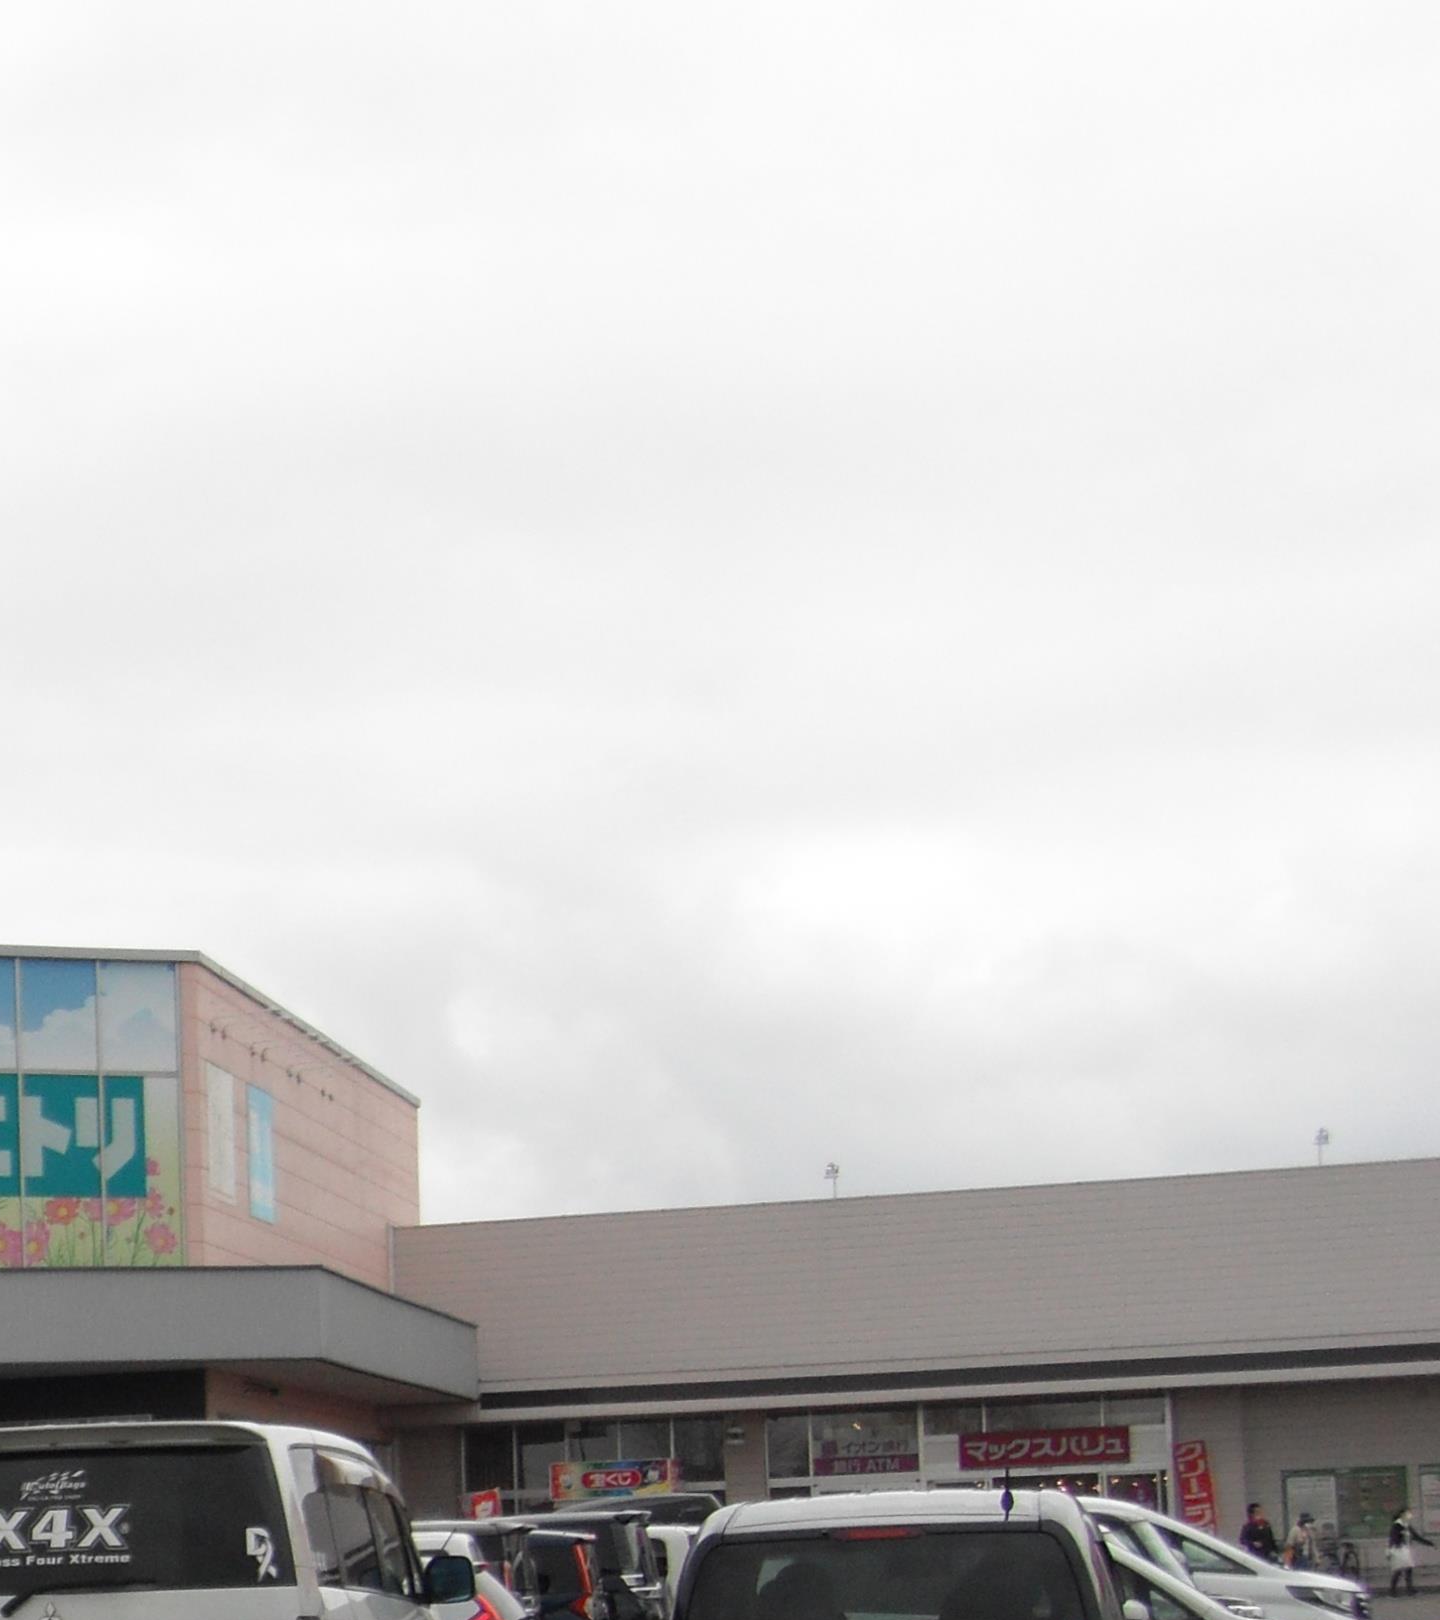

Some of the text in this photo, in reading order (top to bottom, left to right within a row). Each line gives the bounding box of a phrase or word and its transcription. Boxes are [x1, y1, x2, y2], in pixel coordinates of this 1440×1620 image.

[963, 1434, 1125, 1462] マックスバリュ
[1177, 1443, 1217, 1534] クリーニン
[25, 1555, 64, 1566] Four
[69, 1553, 131, 1565] Xtreme
